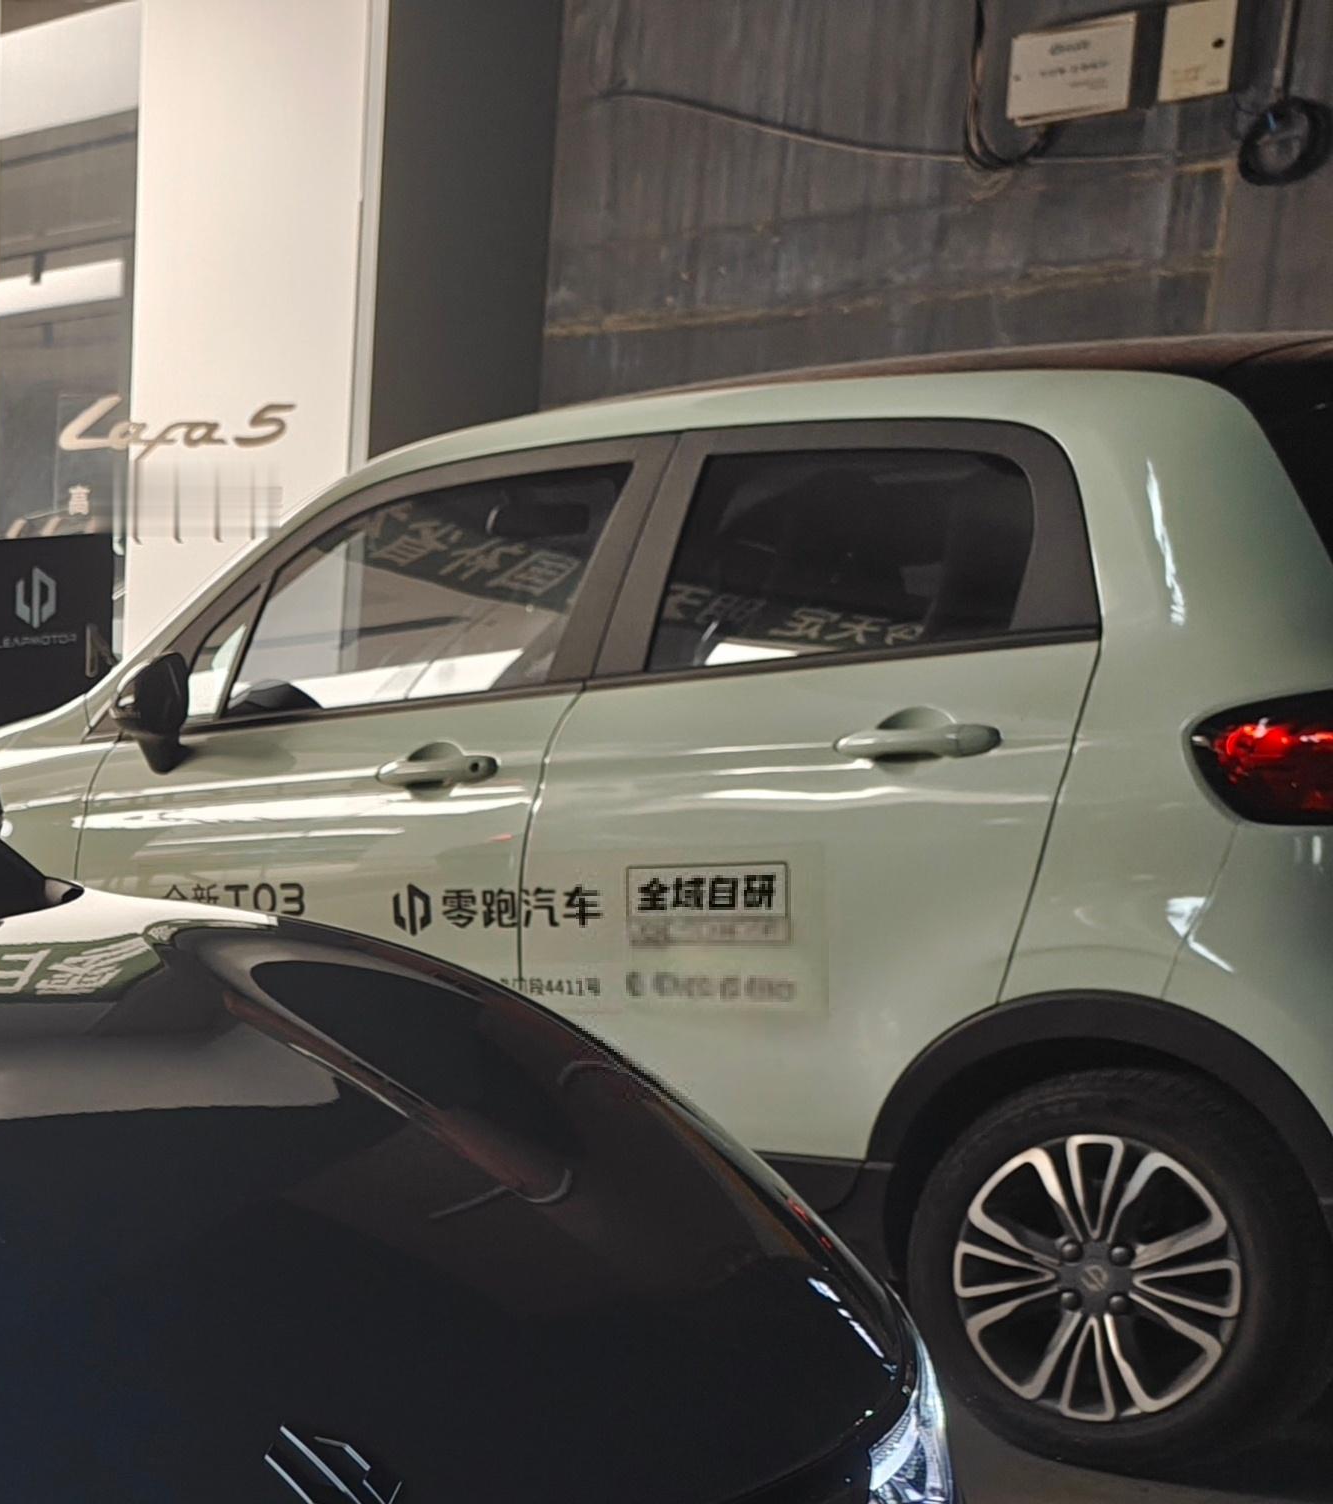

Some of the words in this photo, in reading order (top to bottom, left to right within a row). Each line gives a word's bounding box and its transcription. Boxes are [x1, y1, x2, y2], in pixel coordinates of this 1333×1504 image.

[441, 886, 604, 929] 零跑汽车
[636, 874, 778, 912] 全域自研
